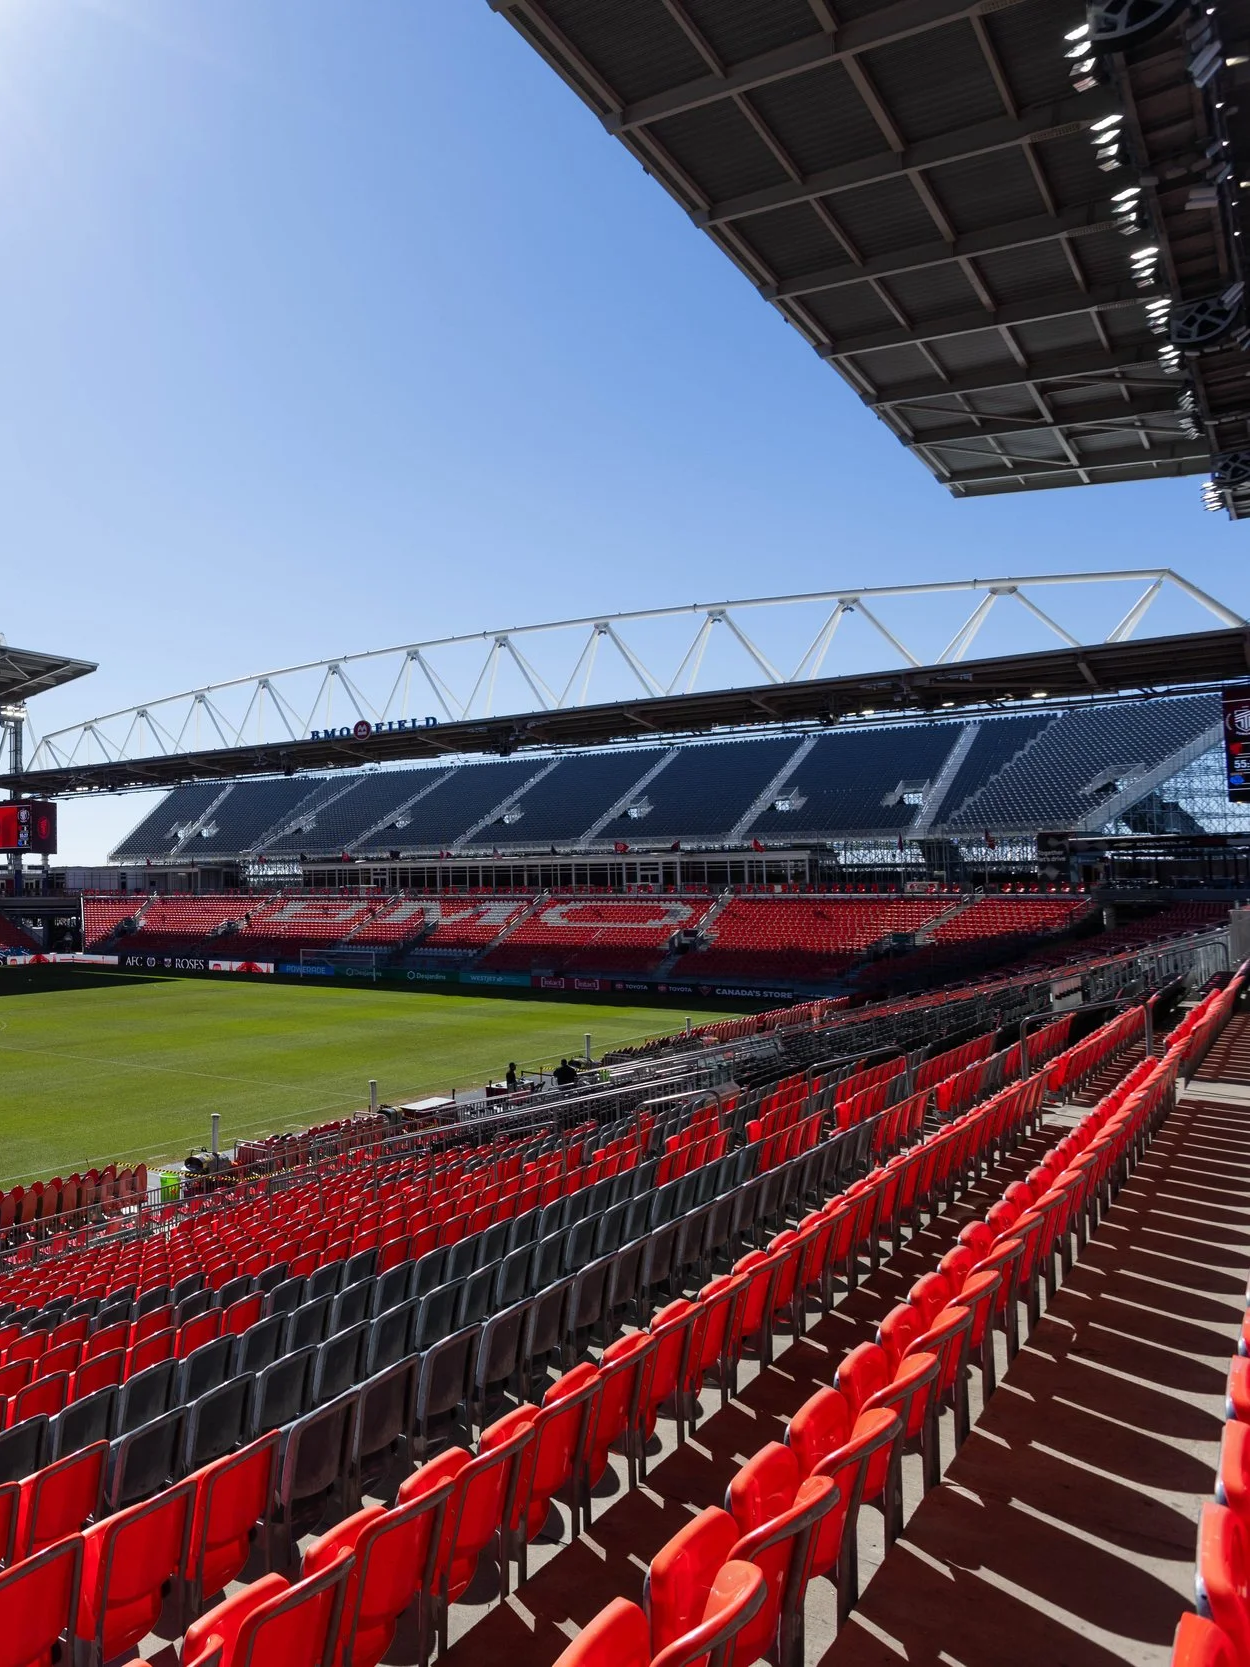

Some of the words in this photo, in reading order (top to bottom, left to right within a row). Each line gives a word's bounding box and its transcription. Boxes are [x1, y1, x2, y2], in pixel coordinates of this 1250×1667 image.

[311, 727, 351, 741] BMO
[375, 716, 438, 734] FIELD
[125, 956, 144, 967] AFC
[175, 958, 204, 970] ROSES
[286, 964, 326, 975] POWERADE
[416, 972, 446, 982] Desjardins
[625, 983, 649, 991] TOYOTA
[668, 985, 693, 993] TOYOTA
[715, 987, 762, 998] CANADA'S
[763, 990, 793, 1000] STORE
